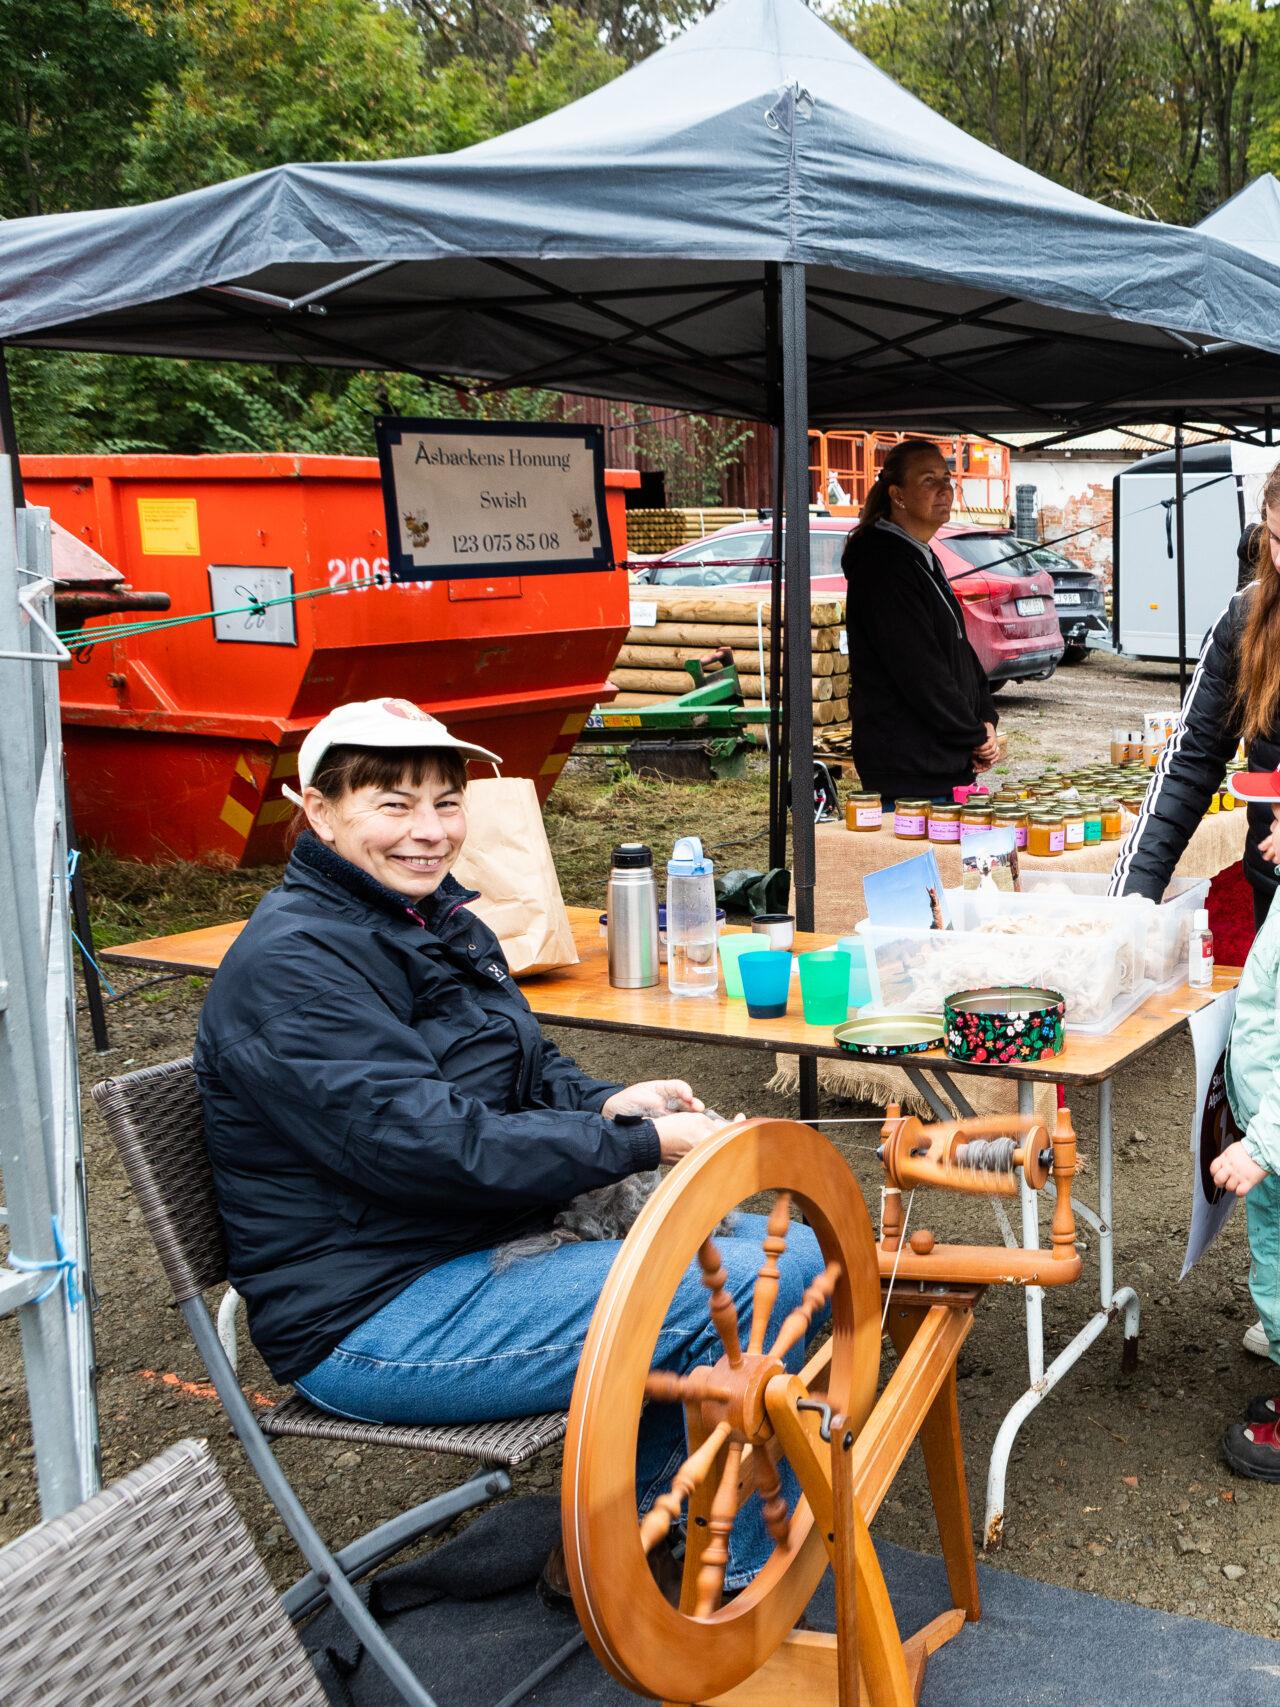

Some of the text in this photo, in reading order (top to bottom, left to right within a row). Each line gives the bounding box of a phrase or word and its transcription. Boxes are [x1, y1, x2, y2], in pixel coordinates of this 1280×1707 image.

[414, 441, 571, 473] Åsbackens Honung
[480, 490, 527, 509] Swish
[453, 532, 560, 553] 123 075 85 08
